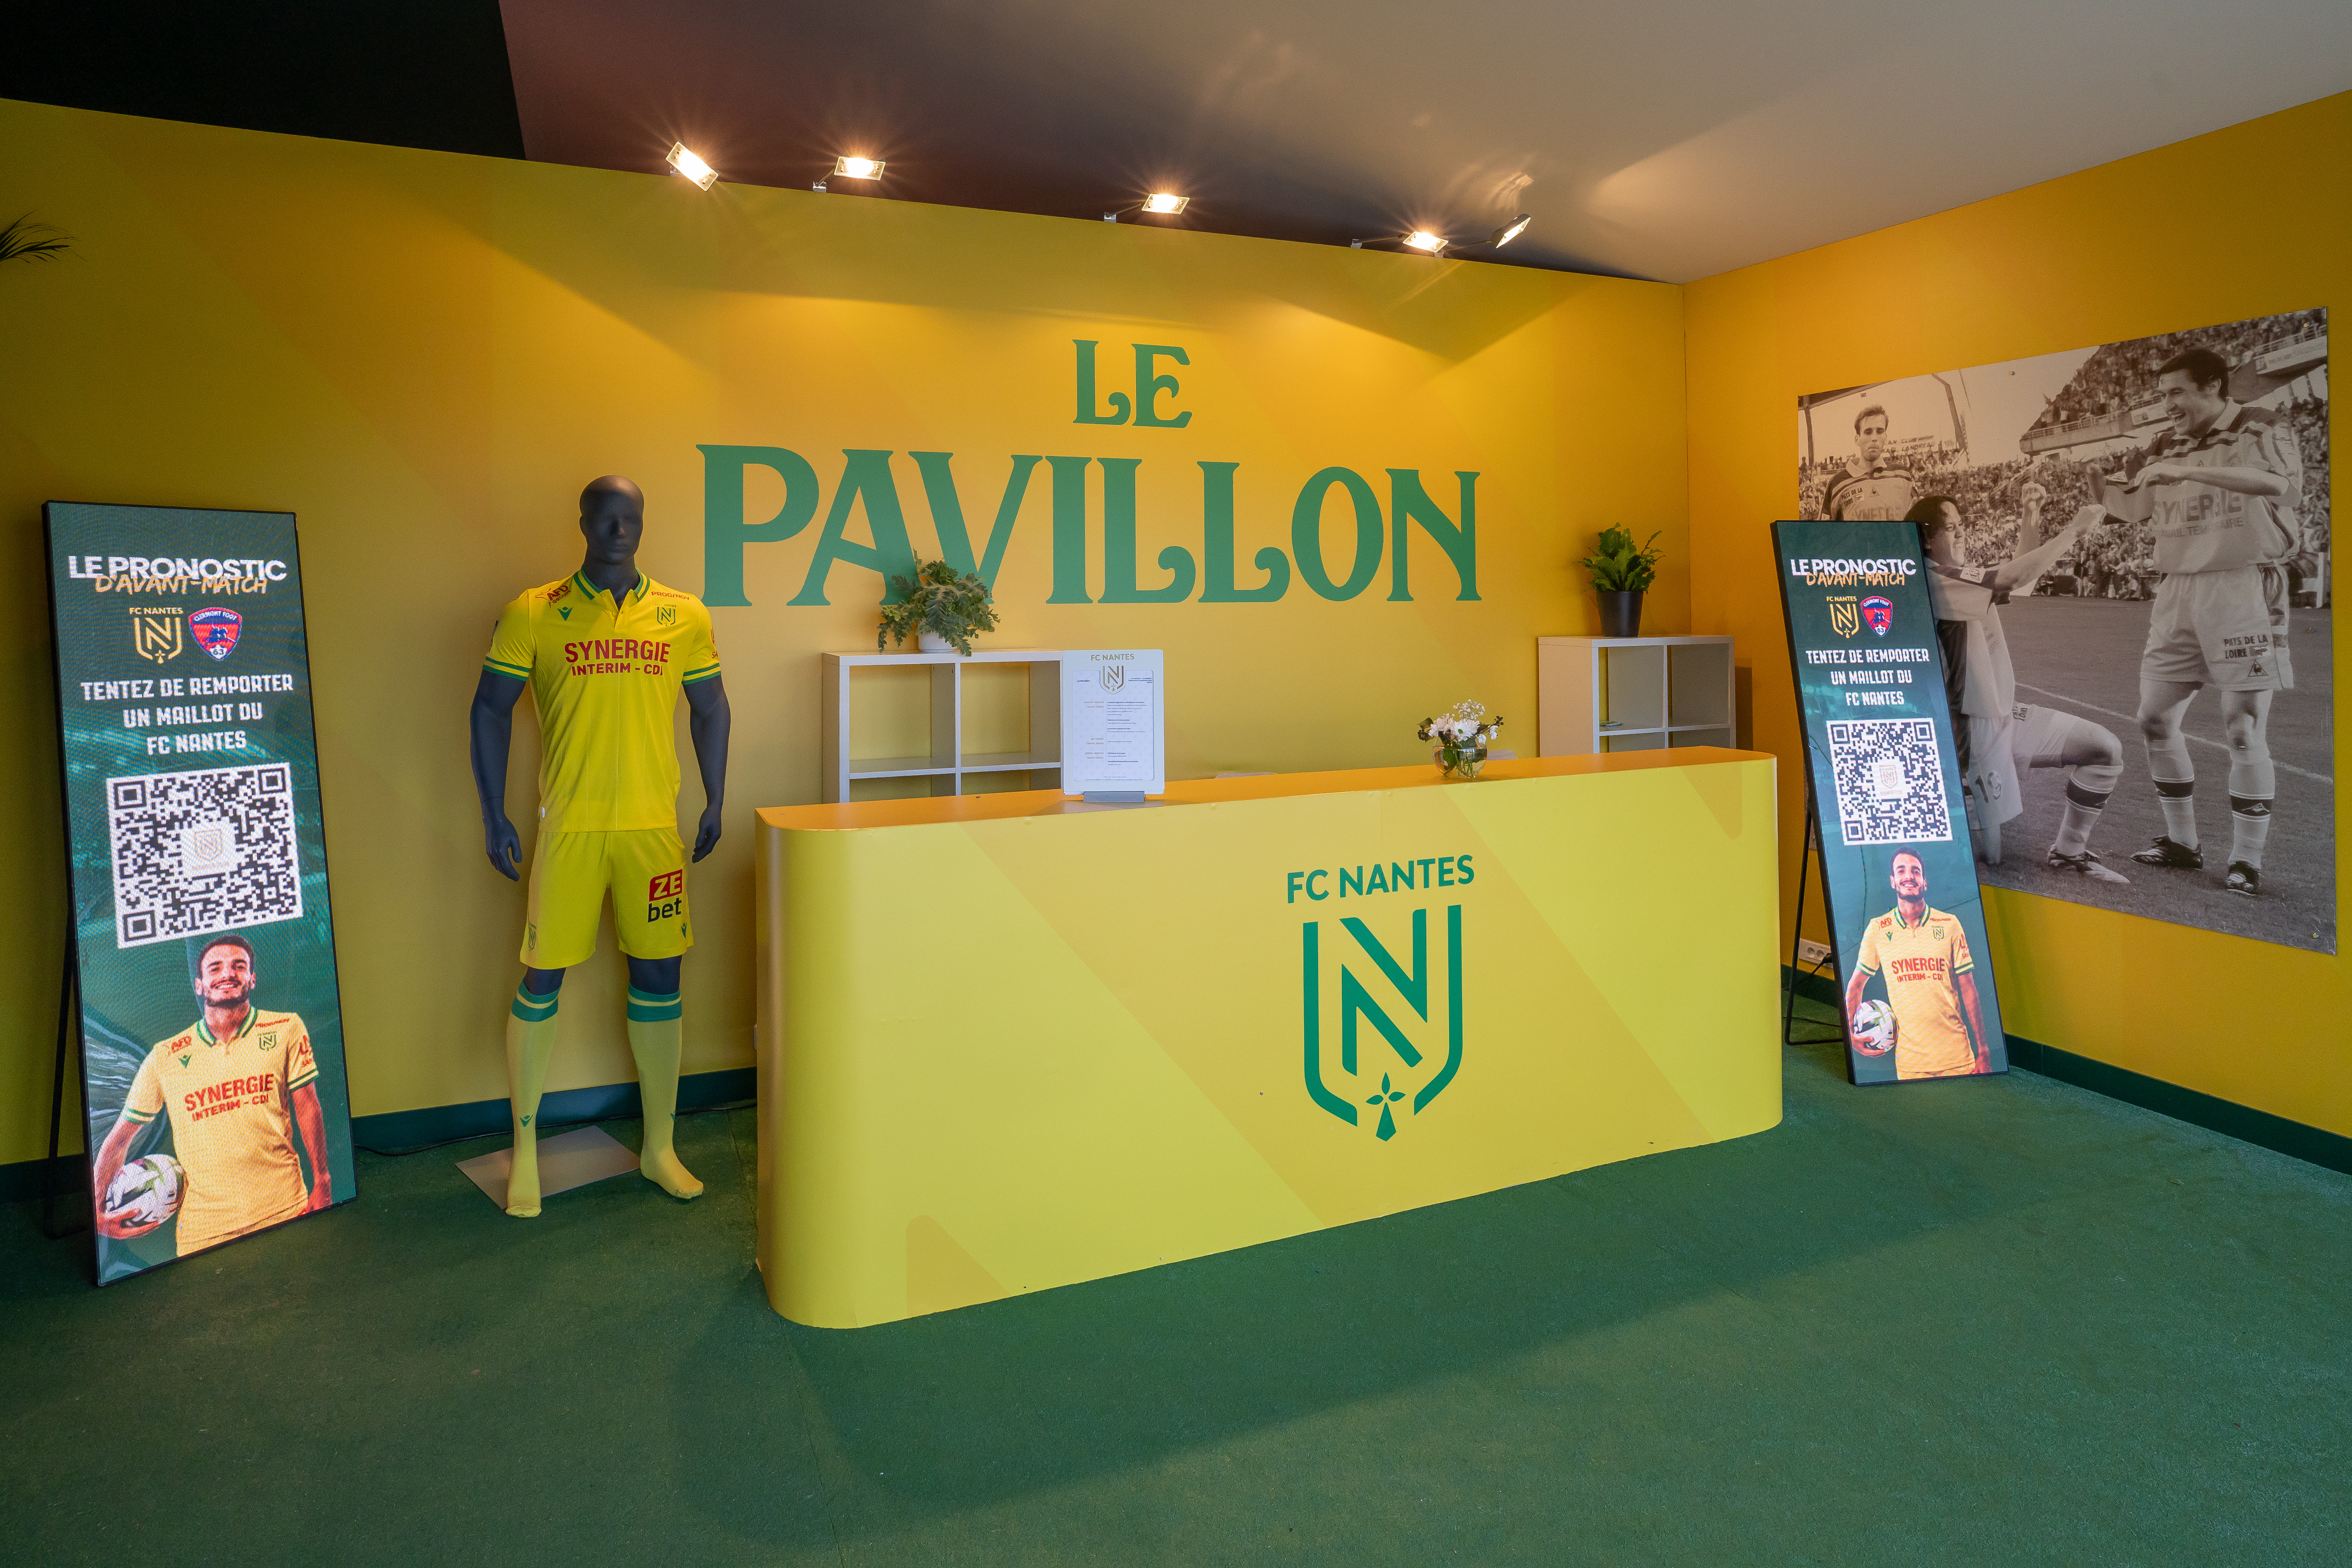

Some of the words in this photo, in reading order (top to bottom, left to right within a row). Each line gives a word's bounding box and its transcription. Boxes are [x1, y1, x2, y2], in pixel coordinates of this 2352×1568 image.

[1072, 339, 1192, 429] LE
[696, 444, 1480, 607] PAVILLON
[68, 556, 103, 579] LE
[108, 556, 287, 581] PRONOSTIC
[1790, 558, 1808, 575] LE
[1811, 558, 1917, 575] PRONOSTIC
[547, 585, 569, 601] AFD
[552, 590, 571, 603] GROUPE
[2223, 637, 2242, 647] PAYS
[2244, 636, 2255, 644] DE
[2257, 633, 2268, 643] LA
[564, 639, 671, 663] SYNERGIE
[1805, 650, 1847, 664] TENTEZ
[1848, 649, 1864, 663] DE
[1865, 648, 1930, 663] REMPORTER
[2225, 648, 2247, 659] LOIRE
[572, 663, 630, 676] INTERIM
[643, 664, 663, 676] CDI
[1830, 671, 1847, 685] UN
[1849, 670, 1894, 685] MAILLOT
[1896, 670, 1912, 684] DU
[80, 680, 154, 701] TENTEZ
[160, 678, 185, 697] DE
[190, 674, 293, 696] REMPORTER
[1845, 692, 1860, 706] FC
[1861, 691, 1905, 706] NANTES
[123, 708, 151, 728] UN
[157, 703, 234, 726] MAILLOT
[239, 702, 263, 721] DU
[147, 735, 170, 755] FC
[176, 730, 247, 753] NANTES
[654, 872, 682, 898] ZE
[1287, 869, 1330, 904] FC
[1340, 855, 1474, 898] NANTES
[648, 897, 682, 923] bet
[1881, 918, 1892, 926] AFD
[1892, 958, 1945, 974] SYNERGIE
[1897, 973, 1926, 983] INTERIM
[185, 1074, 274, 1112] SYNERGIE
[192, 1099, 240, 1122] INTERIM
[252, 1094, 269, 1105] CDI
